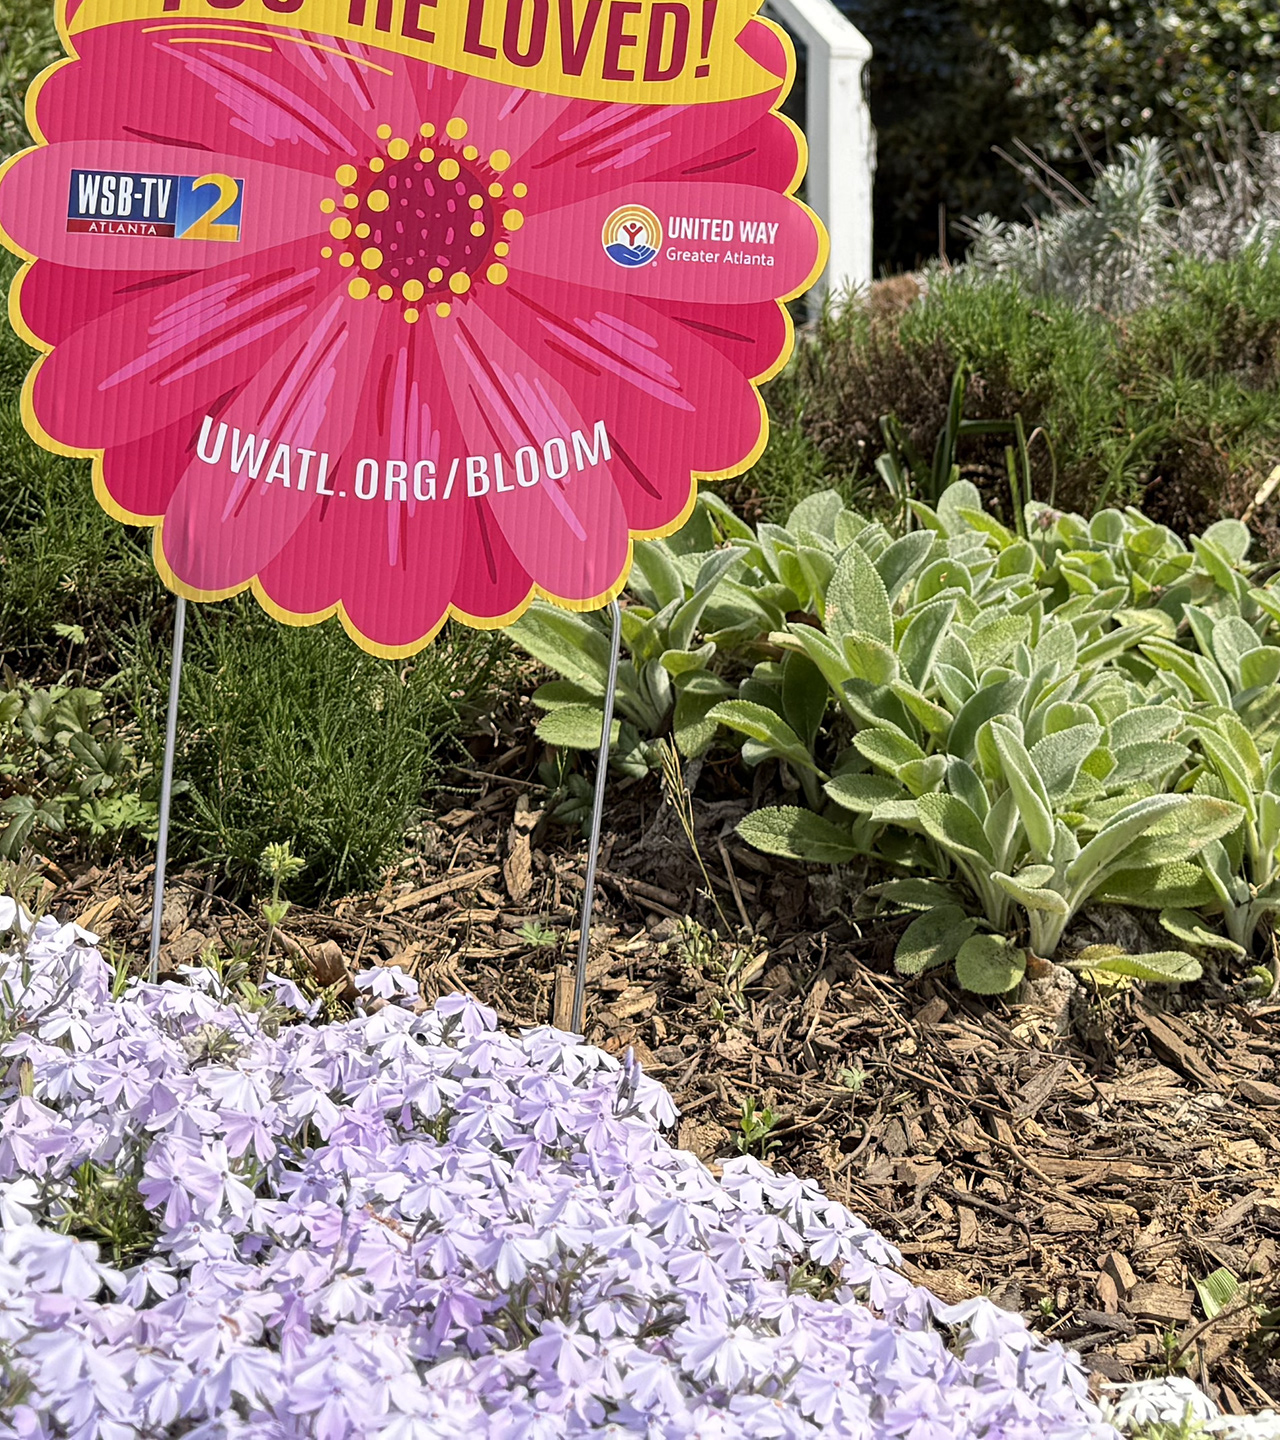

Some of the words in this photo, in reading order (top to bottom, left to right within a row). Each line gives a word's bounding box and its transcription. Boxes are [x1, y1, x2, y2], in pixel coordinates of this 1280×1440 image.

[78, 173, 172, 219] WSB-TV
[179, 173, 239, 242] 2
[88, 221, 157, 236] ATLANTA
[667, 216, 734, 242] UNITED
[739, 220, 779, 244] WAY
[666, 246, 720, 264] Greater
[723, 250, 775, 267] Atlanta
[195, 415, 612, 501] UWATL.ORG/BLOOM
